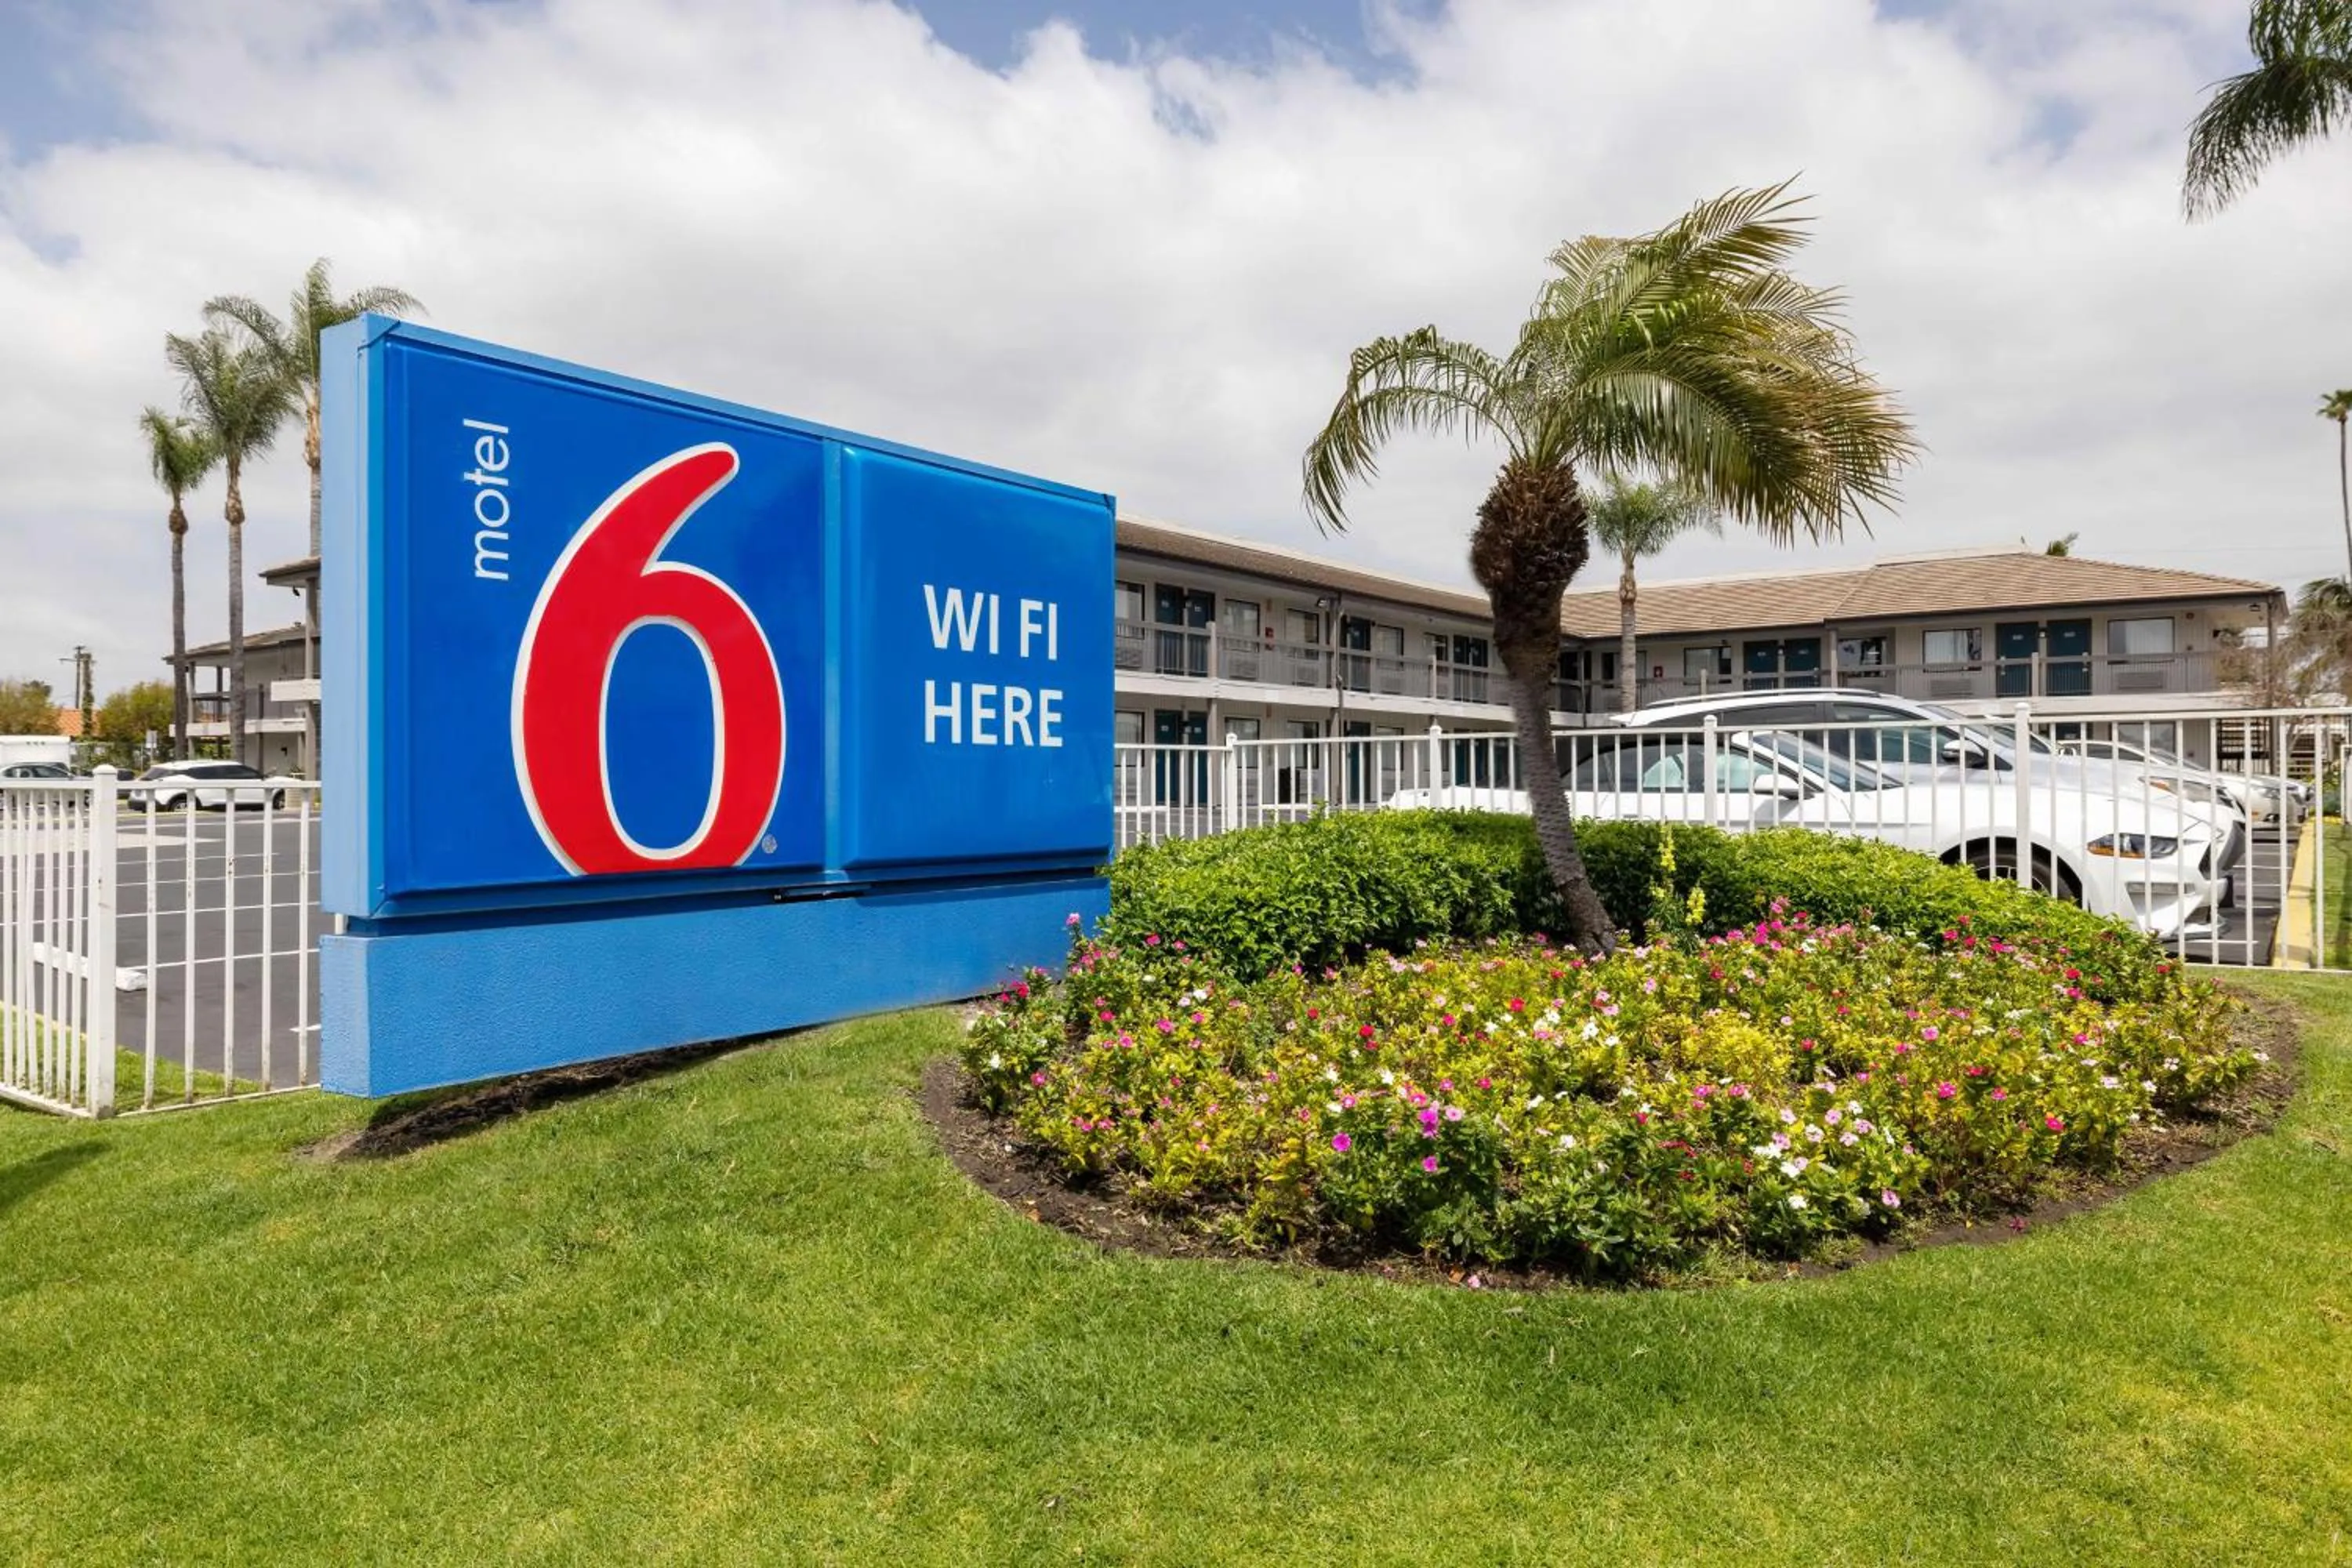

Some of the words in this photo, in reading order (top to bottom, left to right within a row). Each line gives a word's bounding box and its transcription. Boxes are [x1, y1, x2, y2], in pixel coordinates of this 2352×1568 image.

[463, 419, 510, 581] motel
[510, 441, 786, 877] 6
[924, 583, 1000, 655] WI
[1019, 600, 1058, 660] FI
[924, 679, 1064, 748] HERE
